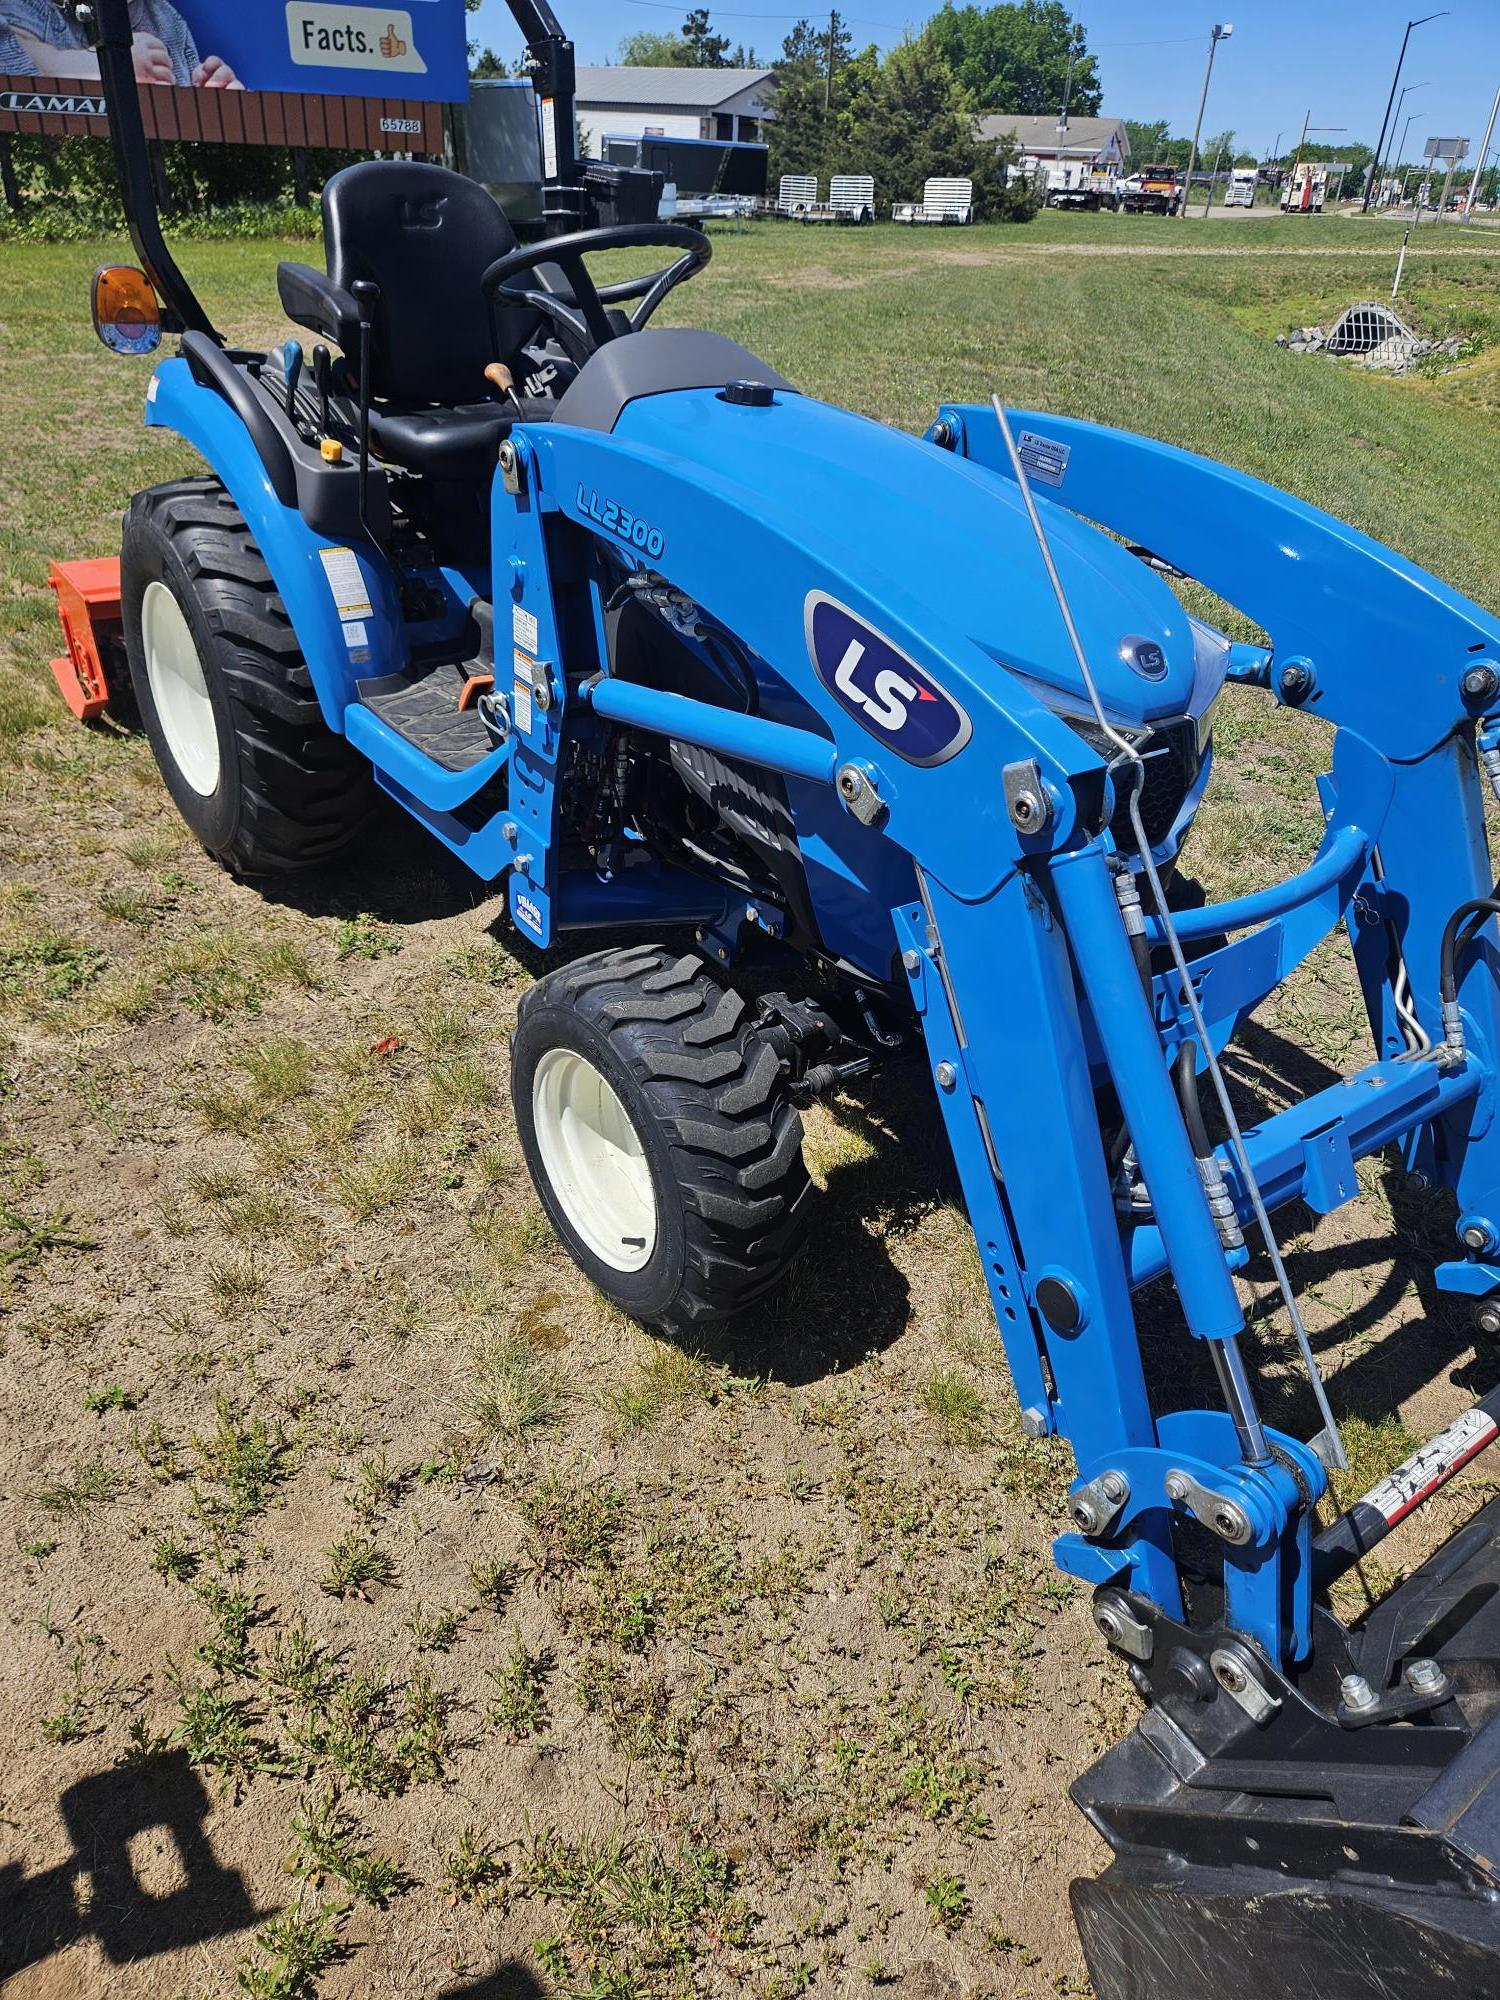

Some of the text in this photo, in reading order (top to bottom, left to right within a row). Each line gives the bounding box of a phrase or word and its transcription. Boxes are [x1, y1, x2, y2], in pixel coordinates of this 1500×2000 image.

[302, 20, 374, 54] Facts.
[382, 119, 419, 132] 65788
[576, 481, 665, 560] LL2300
[1140, 651, 1161, 668] LS
[834, 638, 918, 731] LS
